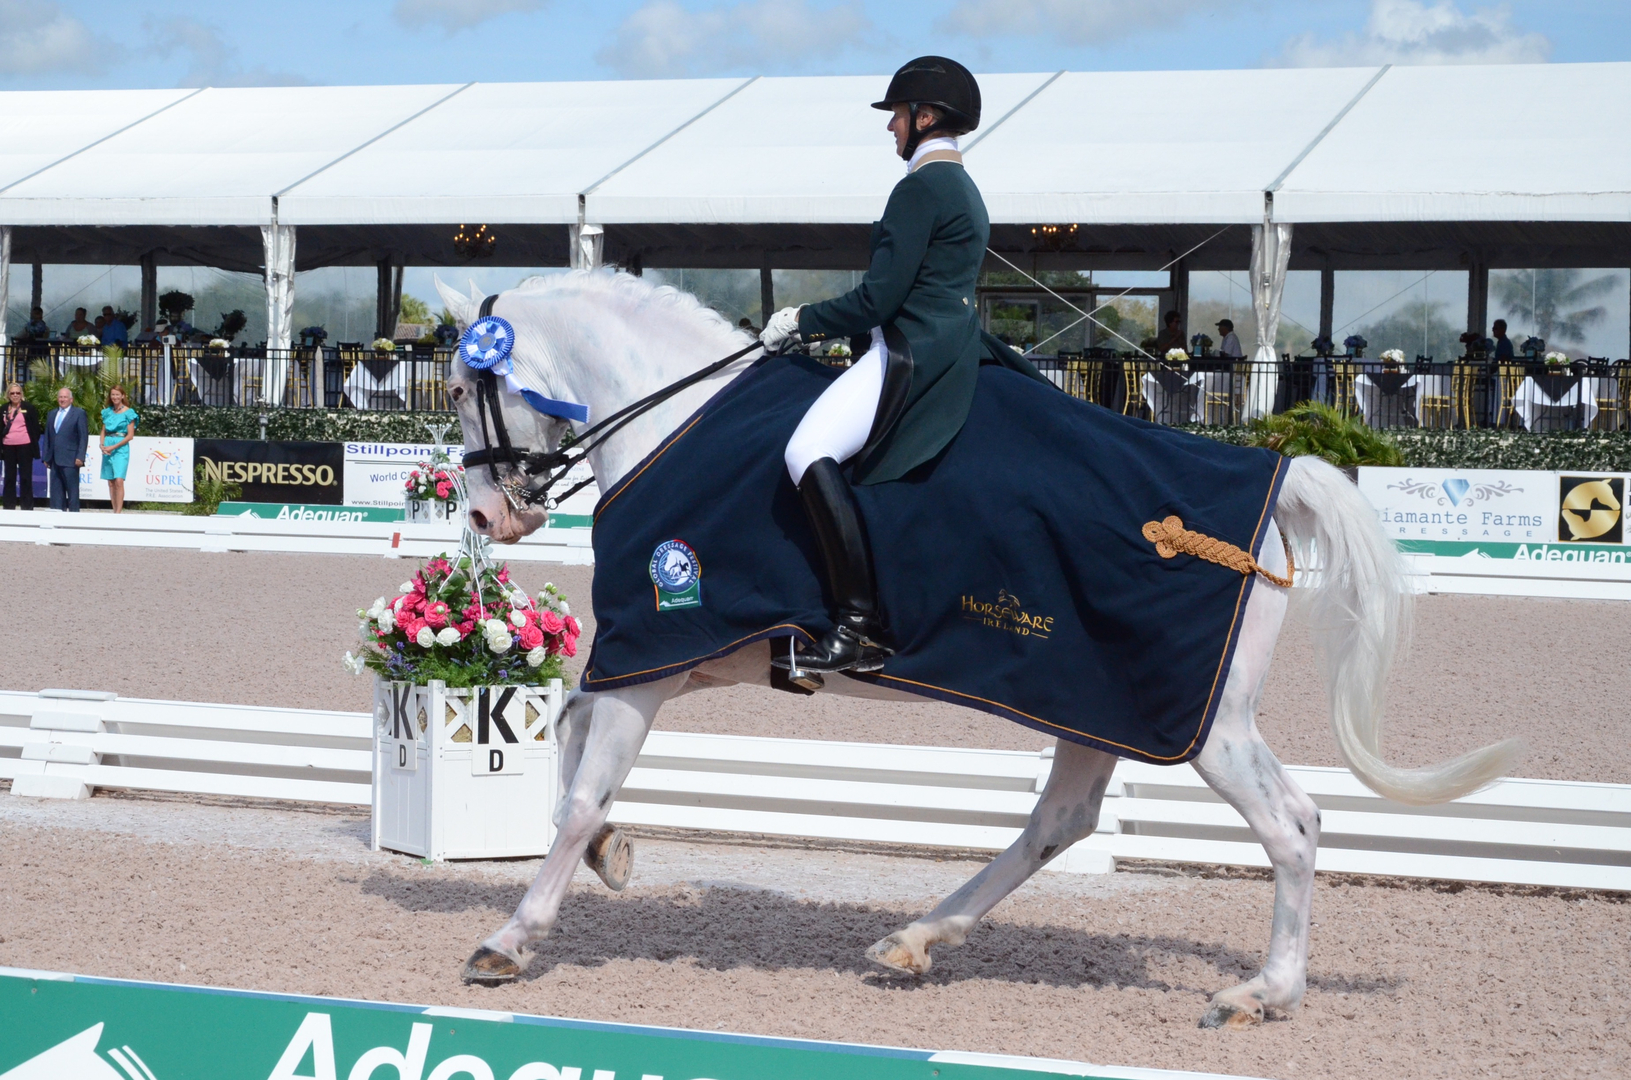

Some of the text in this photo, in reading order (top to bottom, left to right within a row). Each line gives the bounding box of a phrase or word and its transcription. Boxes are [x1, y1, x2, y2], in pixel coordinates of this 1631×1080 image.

[346, 443, 434, 457] Stillpoin
[146, 474, 183, 485] USPRE
[199, 455, 334, 486] NESPRESSO
[369, 471, 398, 483] World
[412, 501, 420, 519] P
[445, 501, 457, 520] P
[1381, 507, 1543, 527] iamante Farms
[1399, 527, 1533, 537] RESSAGE
[983, 617, 1030, 636] IRELAND
[393, 683, 414, 740] K
[477, 686, 520, 744] K
[399, 744, 407, 767] D
[489, 749, 504, 772] D
